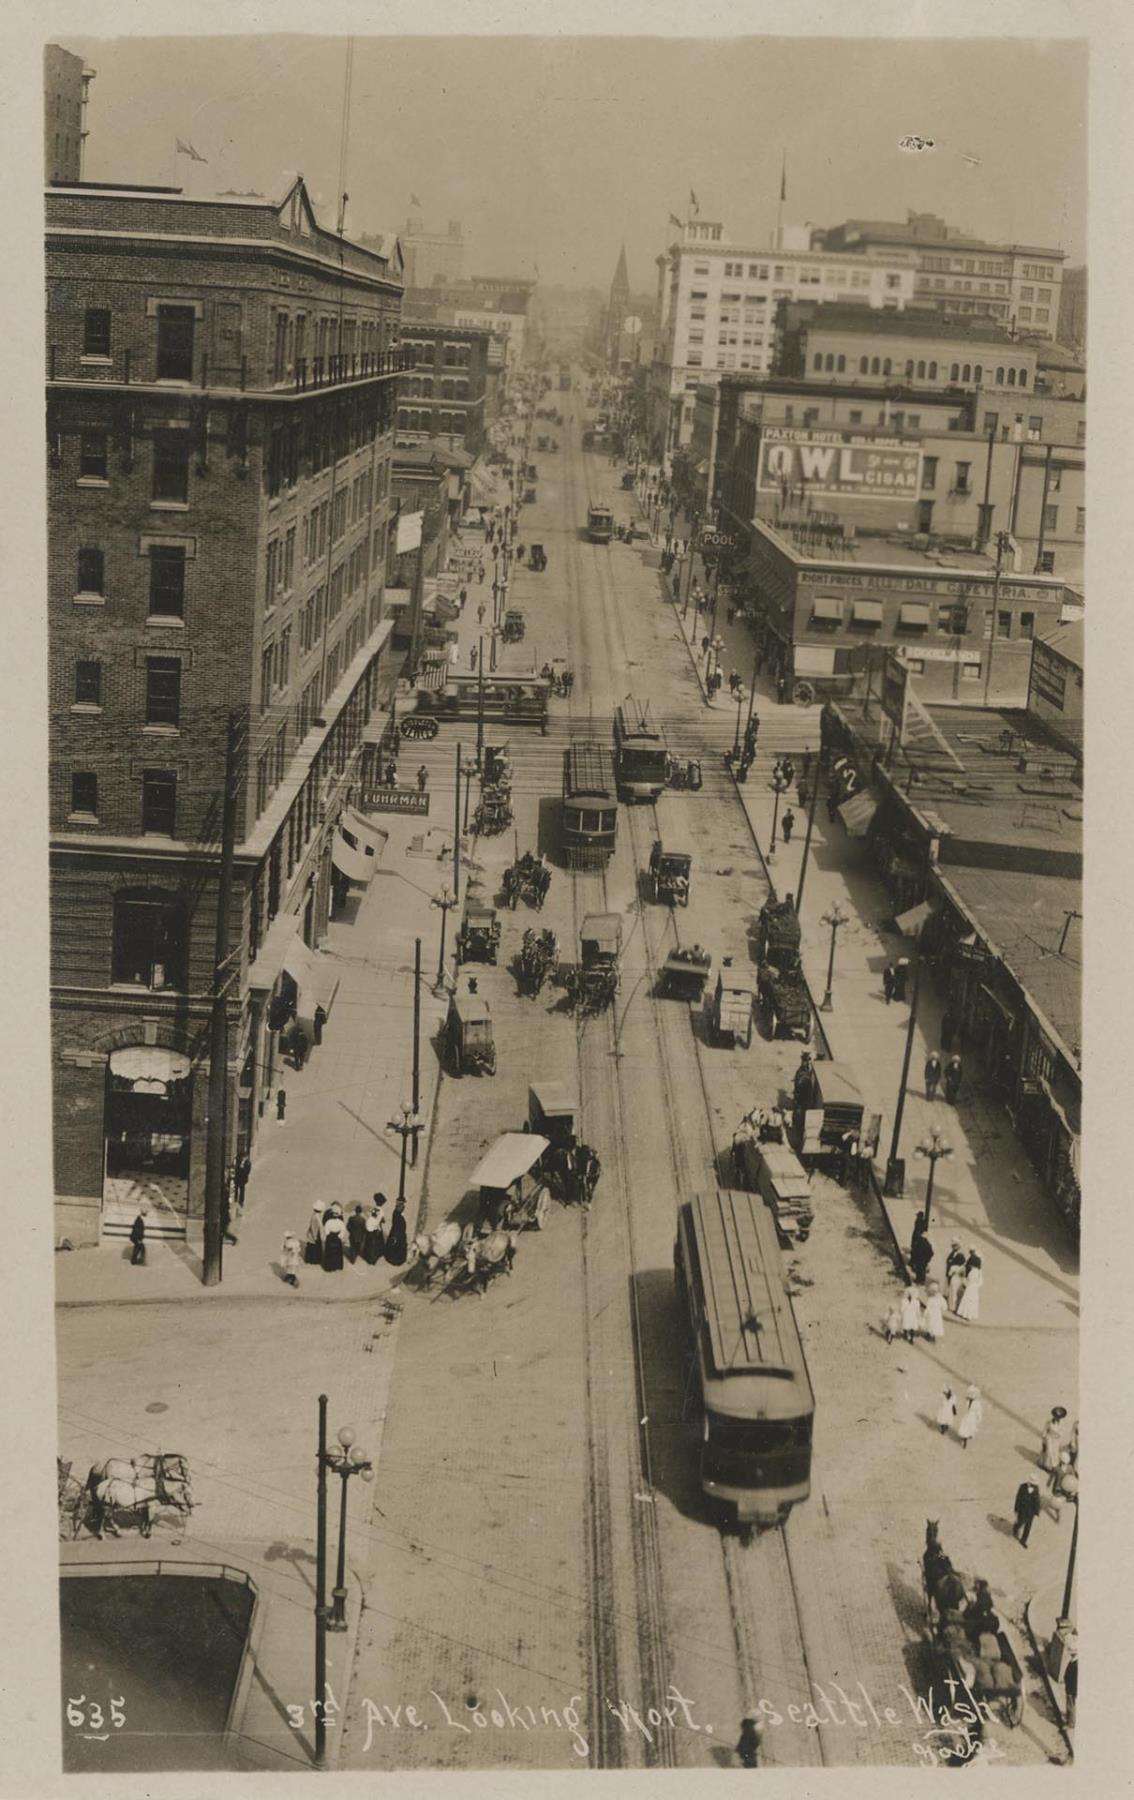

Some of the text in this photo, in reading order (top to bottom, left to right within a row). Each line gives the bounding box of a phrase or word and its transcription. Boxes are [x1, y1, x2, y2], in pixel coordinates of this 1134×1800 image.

[766, 429, 809, 440] PAXTON
[812, 432, 844, 443] HOTEL
[768, 445, 864, 481] OWL
[865, 471, 917, 487] CIGAR
[703, 533, 735, 546] POOL
